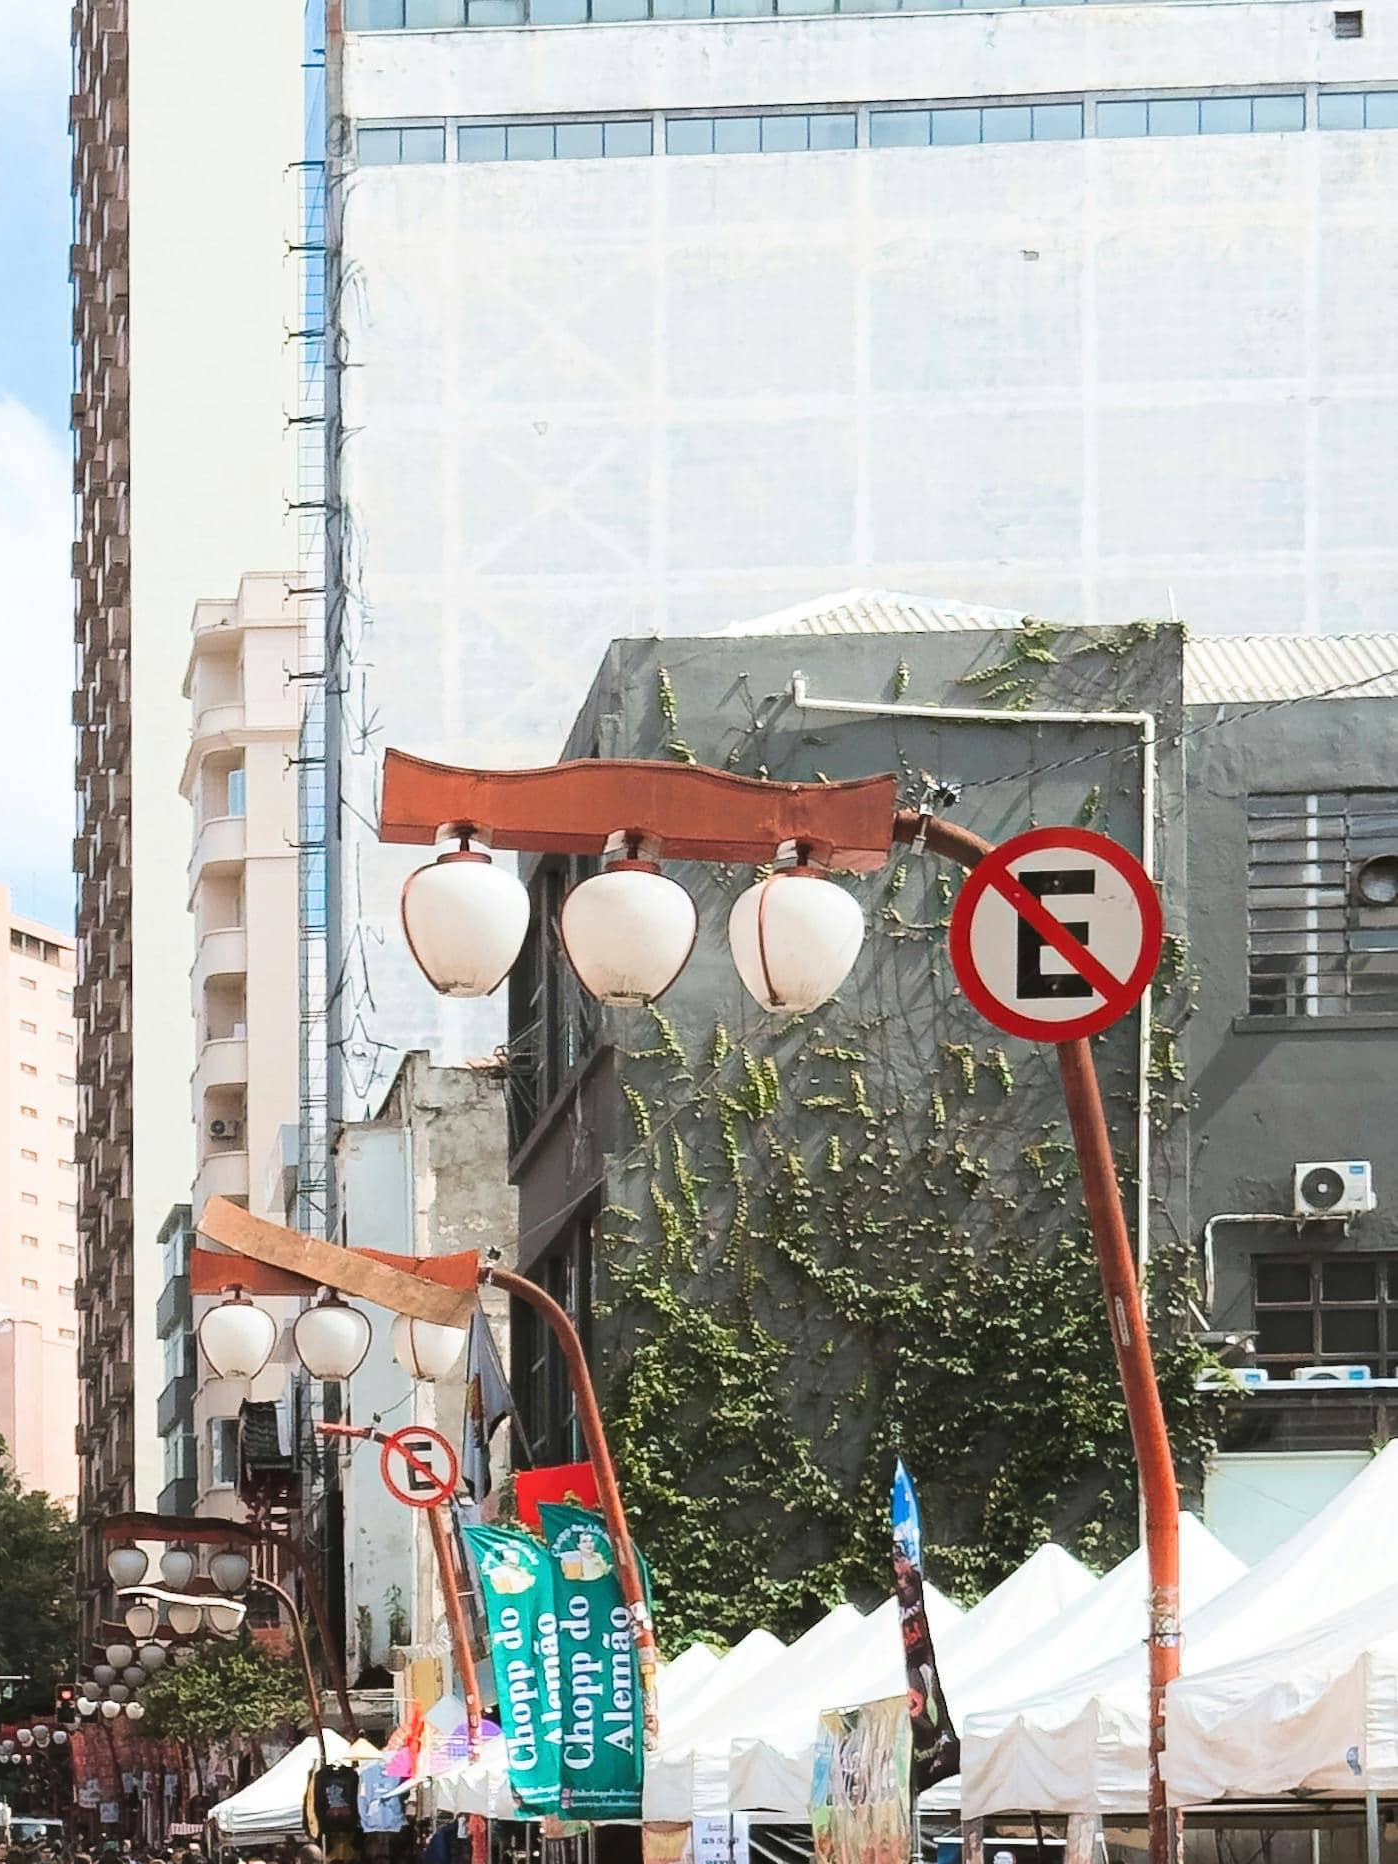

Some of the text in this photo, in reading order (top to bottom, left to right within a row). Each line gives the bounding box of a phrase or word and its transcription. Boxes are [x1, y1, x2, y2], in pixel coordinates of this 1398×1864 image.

[1017, 870, 1095, 999] E
[404, 1442, 436, 1490] E
[493, 1607, 523, 1650] do
[559, 1595, 590, 1641] do
[506, 1660, 539, 1771] Chopp
[533, 1612, 563, 1745] Alemão
[563, 1652, 603, 1770] Chopp
[602, 1606, 634, 1756] Alemão
